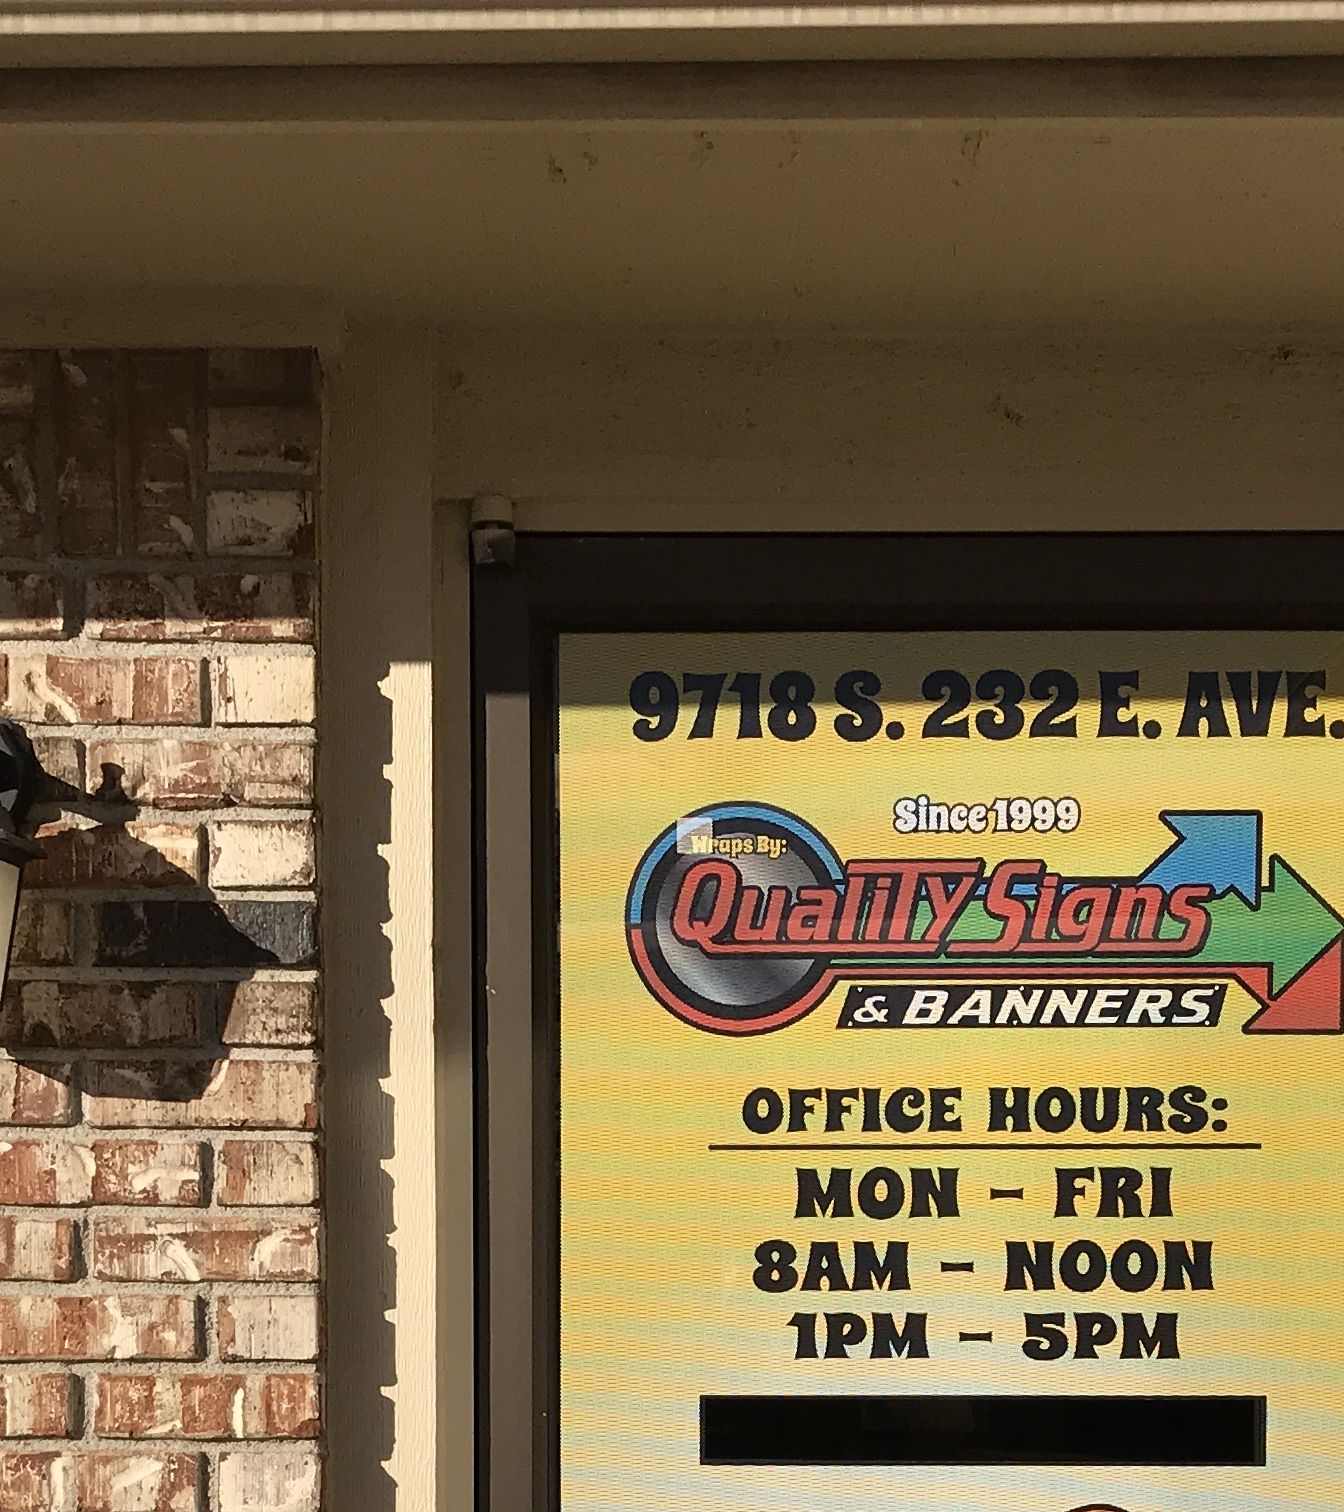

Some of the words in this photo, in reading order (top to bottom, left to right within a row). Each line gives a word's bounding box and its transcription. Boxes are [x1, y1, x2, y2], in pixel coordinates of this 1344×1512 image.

[628, 670, 816, 743] 9718
[833, 670, 905, 741] S.
[920, 670, 1079, 740] 232
[1098, 671, 1162, 741] E.
[893, 794, 988, 833] Since
[988, 796, 1081, 833] 1999
[689, 835, 754, 858] Wraps
[755, 836, 788, 859] By:
[964, 858, 1216, 957] Signs
[853, 993, 890, 1025] &
[901, 989, 1212, 1026] BANNERS
[741, 1086, 963, 1133] OFFICE
[986, 1085, 1229, 1134] HOURS:
[793, 1167, 960, 1219] MON
[1053, 1167, 1175, 1218] FRI
[752, 1239, 911, 1293] 8AM
[1003, 1240, 1215, 1291] NOON
[785, 1311, 929, 1360] 1PM
[1021, 1311, 1181, 1360] 5PM
